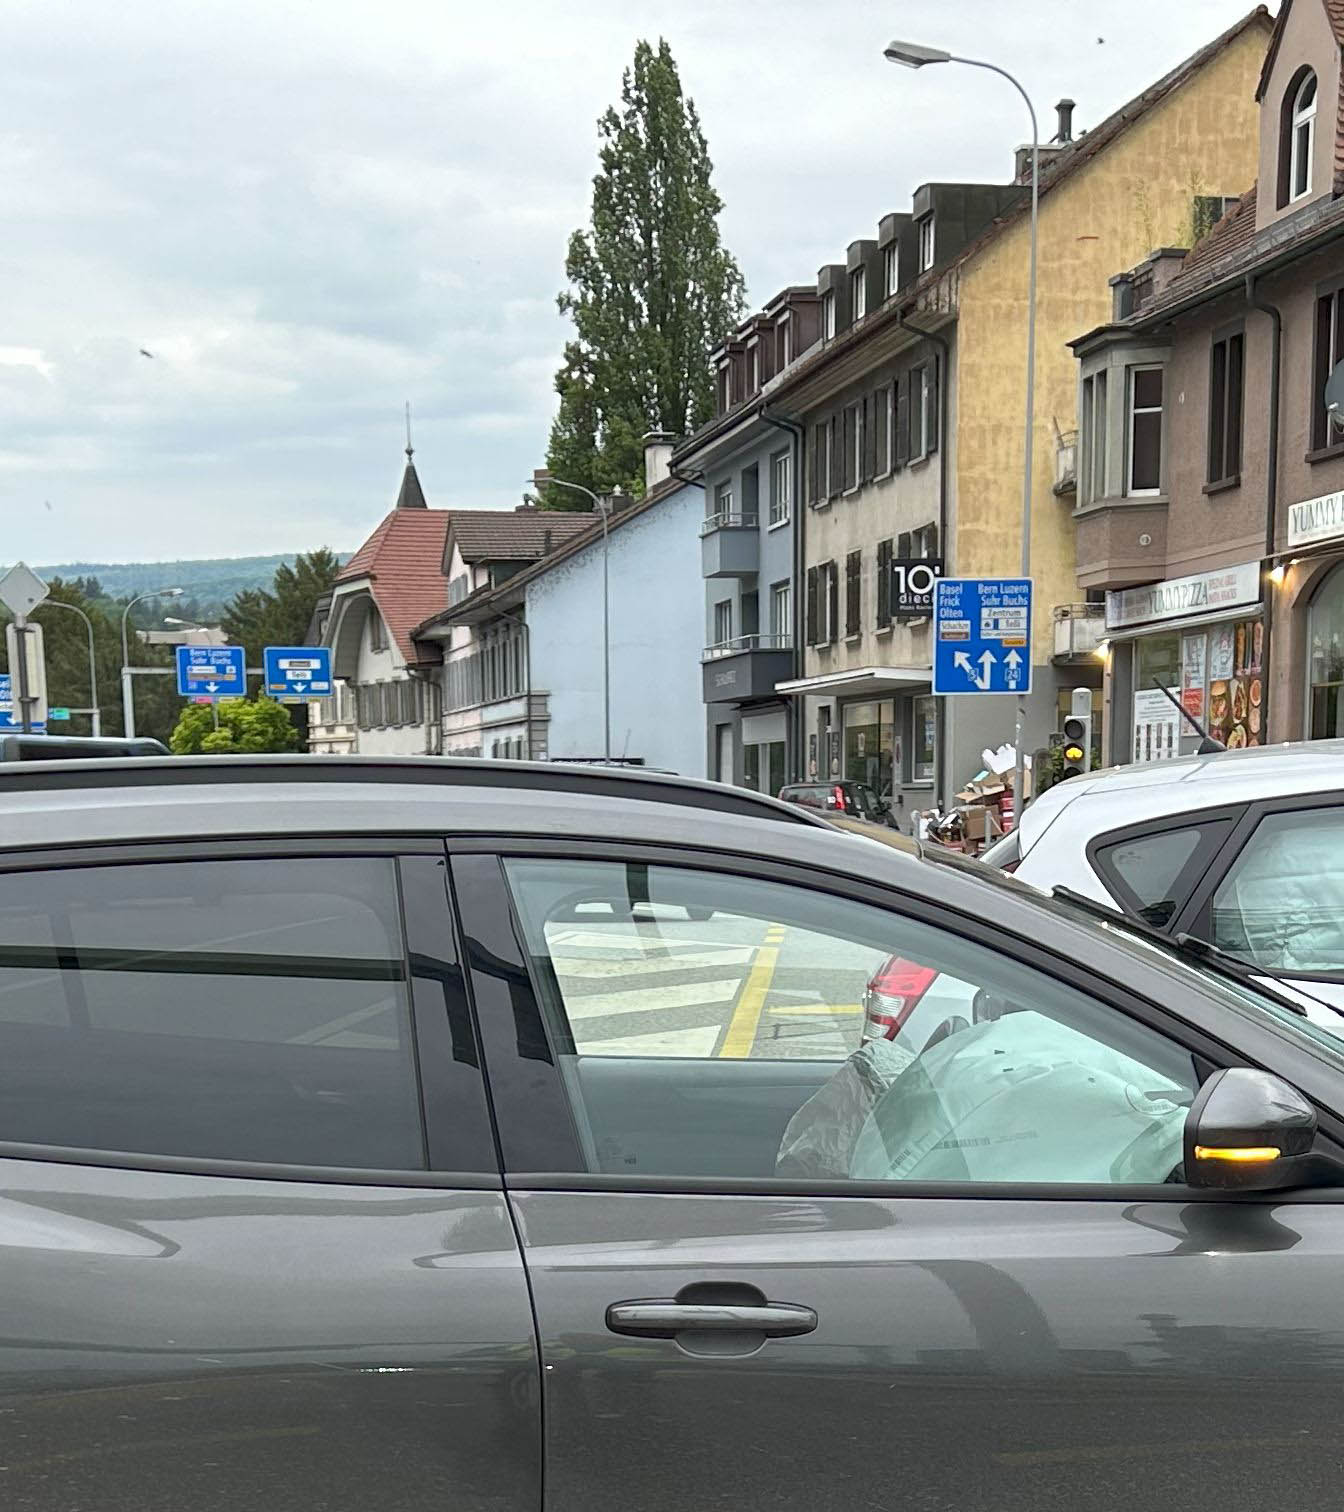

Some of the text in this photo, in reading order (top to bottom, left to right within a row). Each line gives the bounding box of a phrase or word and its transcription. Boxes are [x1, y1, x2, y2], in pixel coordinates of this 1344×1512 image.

[1292, 497, 1338, 533] YUMMY
[939, 583, 963, 594] Basel
[978, 583, 1029, 594] Bern Luzern
[939, 595, 960, 606] Frick
[981, 594, 1028, 606] Suhr Buchs
[939, 607, 963, 618] Olten
[987, 608, 1021, 617] Zentrum
